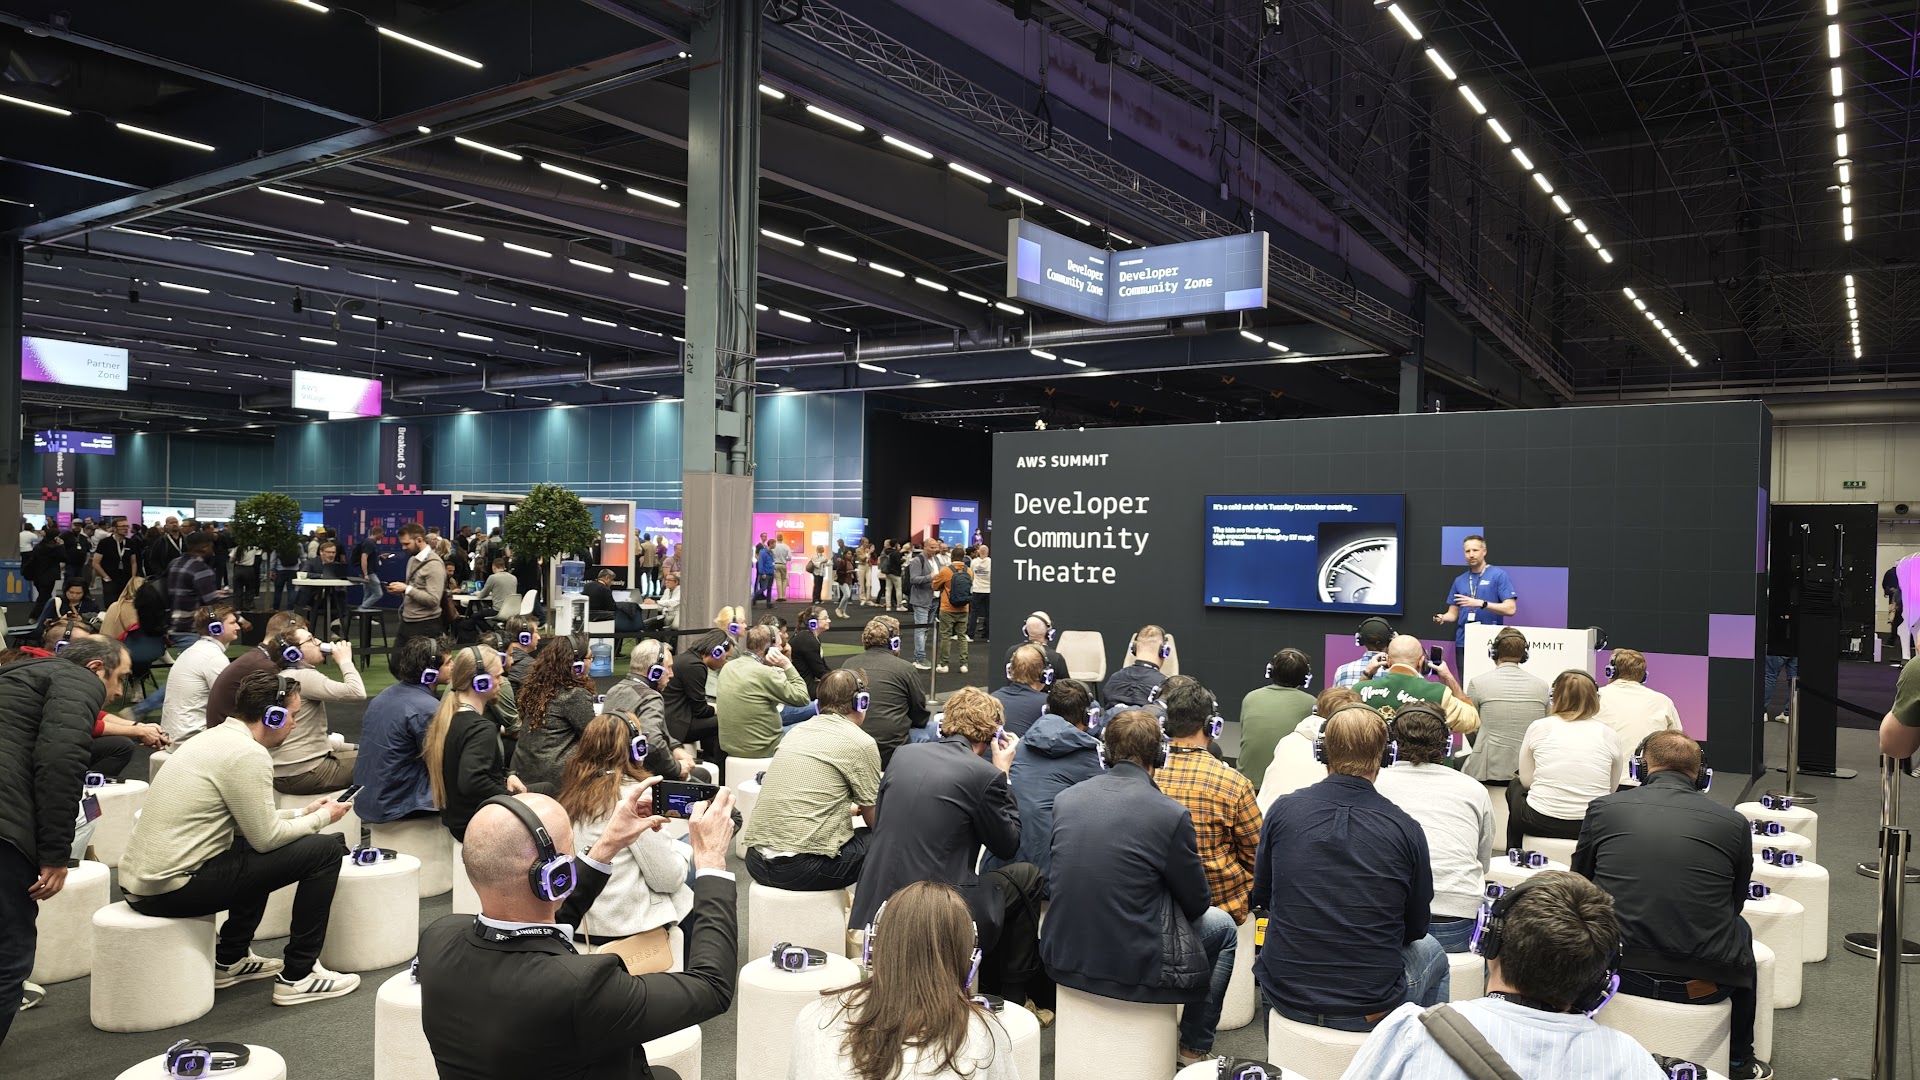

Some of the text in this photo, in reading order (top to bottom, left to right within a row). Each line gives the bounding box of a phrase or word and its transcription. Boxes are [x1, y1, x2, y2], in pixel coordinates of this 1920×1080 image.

[1067, 259, 1104, 281] Developer
[1119, 267, 1179, 282] Developer
[1046, 268, 1103, 296] Community Zone
[1119, 278, 1213, 297] Community Zone
[87, 358, 120, 370] Partner
[686, 342, 694, 375] AP2.2
[98, 370, 120, 380] Zone
[302, 384, 318, 392] AWS
[397, 426, 407, 462] Breakout
[1016, 453, 1109, 468] AWS SUMMIT
[1014, 490, 1150, 520] Developer
[1212, 503, 1223, 511] It's
[1228, 503, 1241, 511] cold
[1241, 503, 1254, 511] and
[1254, 503, 1269, 511] dark
[1268, 503, 1294, 512] Tuesday
[1294, 503, 1327, 511] December
[783, 519, 804, 529] GitLab
[1212, 525, 1225, 533] The
[1013, 525, 1150, 556] Community
[1265, 534, 1289, 542] Naughty
[1297, 534, 1316, 542] magic
[1013, 558, 1116, 584] Theatre
[624, 944, 660, 967] UESS
